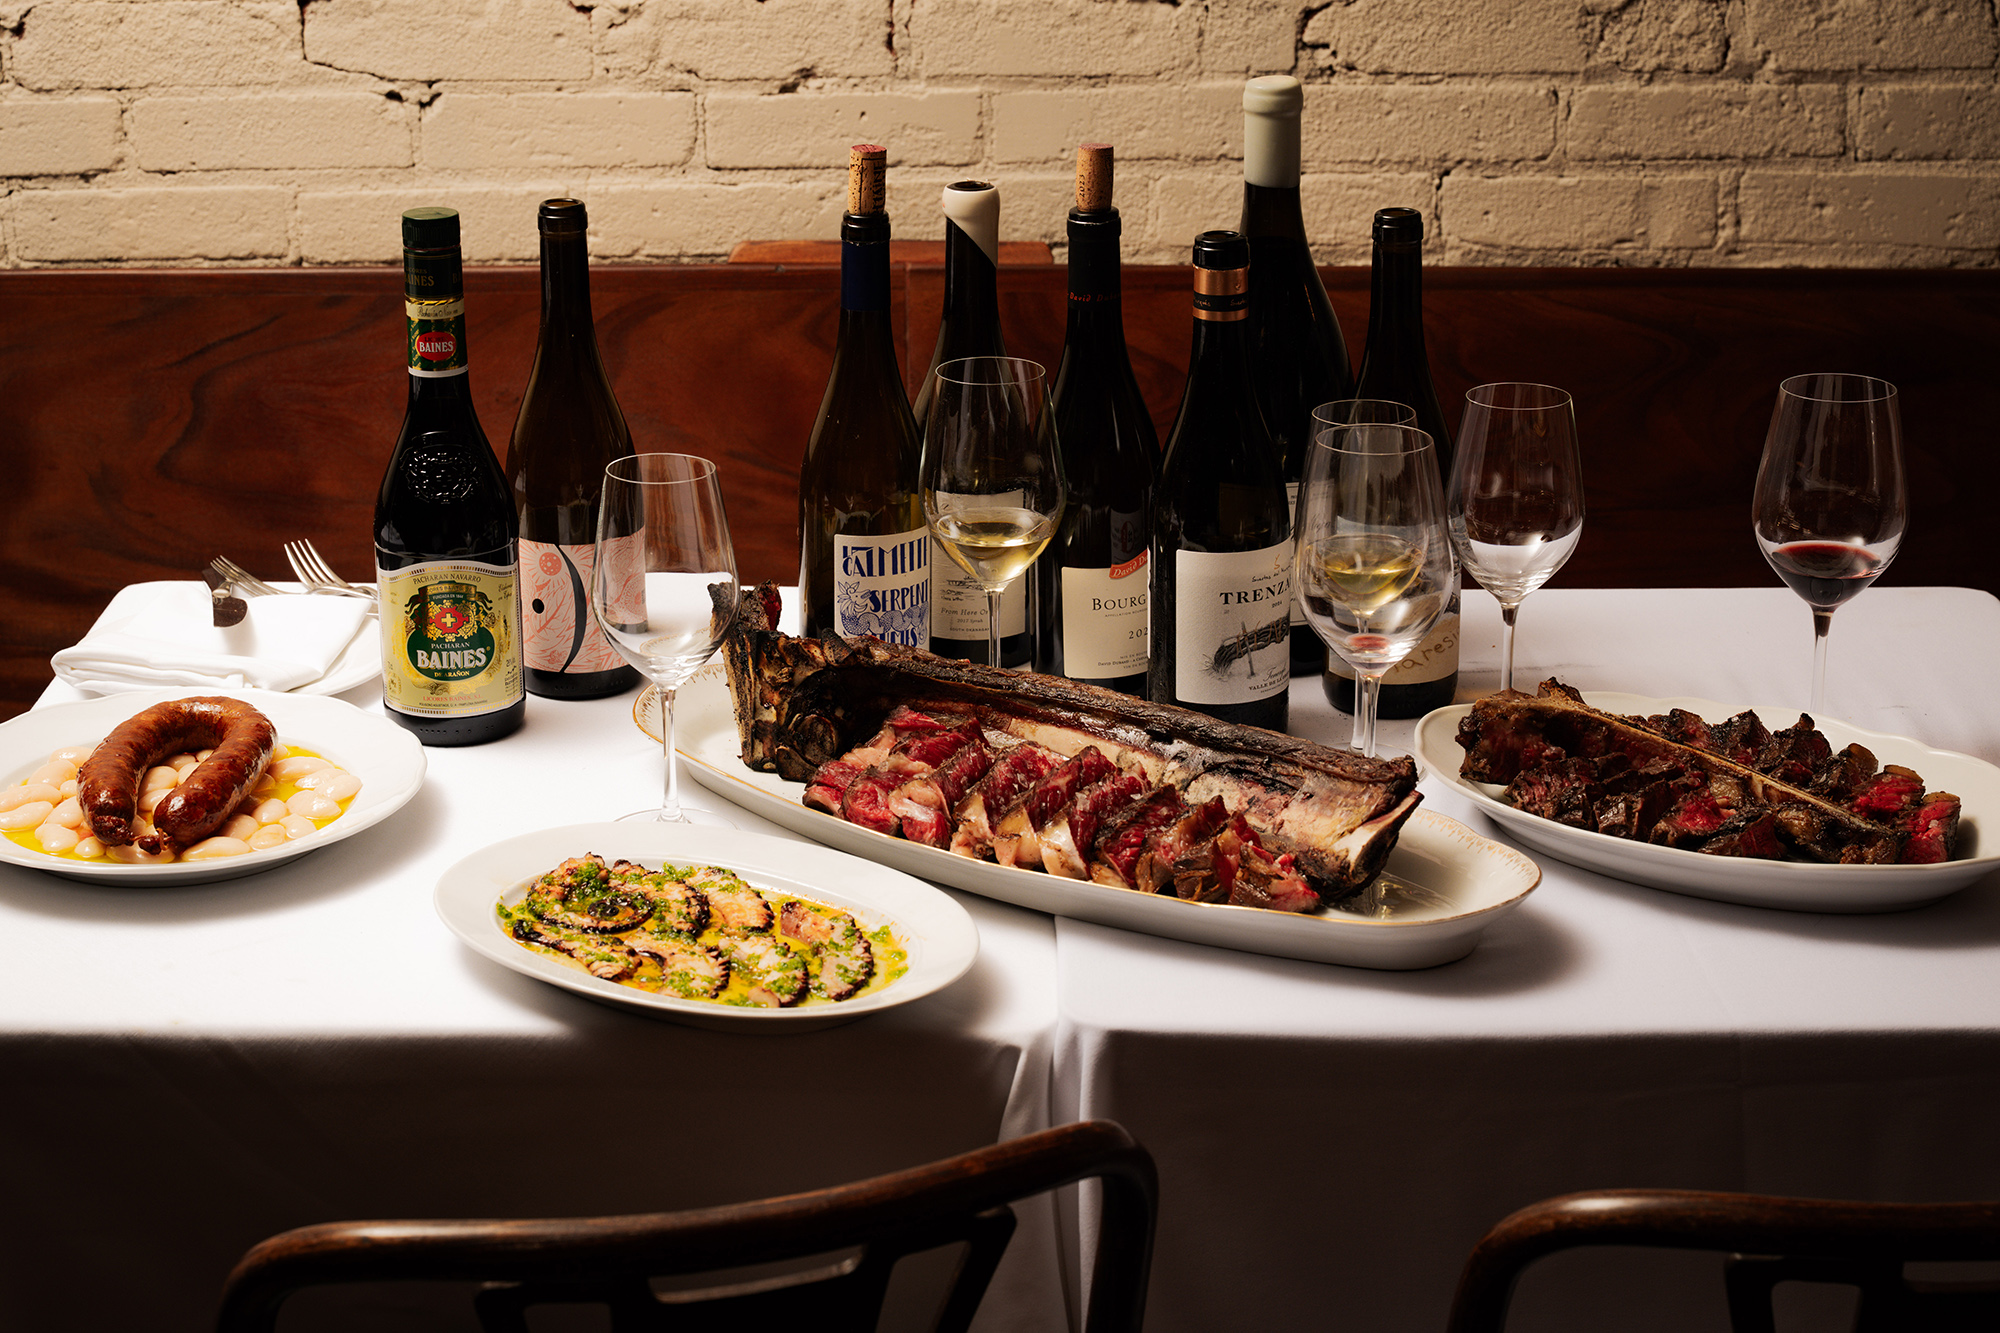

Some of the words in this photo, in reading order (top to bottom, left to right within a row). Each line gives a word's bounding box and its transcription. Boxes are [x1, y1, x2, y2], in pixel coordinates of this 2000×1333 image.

[419, 341, 455, 353] BAINES
[1113, 561, 1137, 577] David
[412, 573, 449, 585] PACHARAN
[450, 573, 481, 584] NAVARRO
[961, 608, 977, 616] Here
[416, 647, 488, 670] BAINES
[444, 670, 470, 678] ARAÑON
[1248, 683, 1268, 691] VALLE
